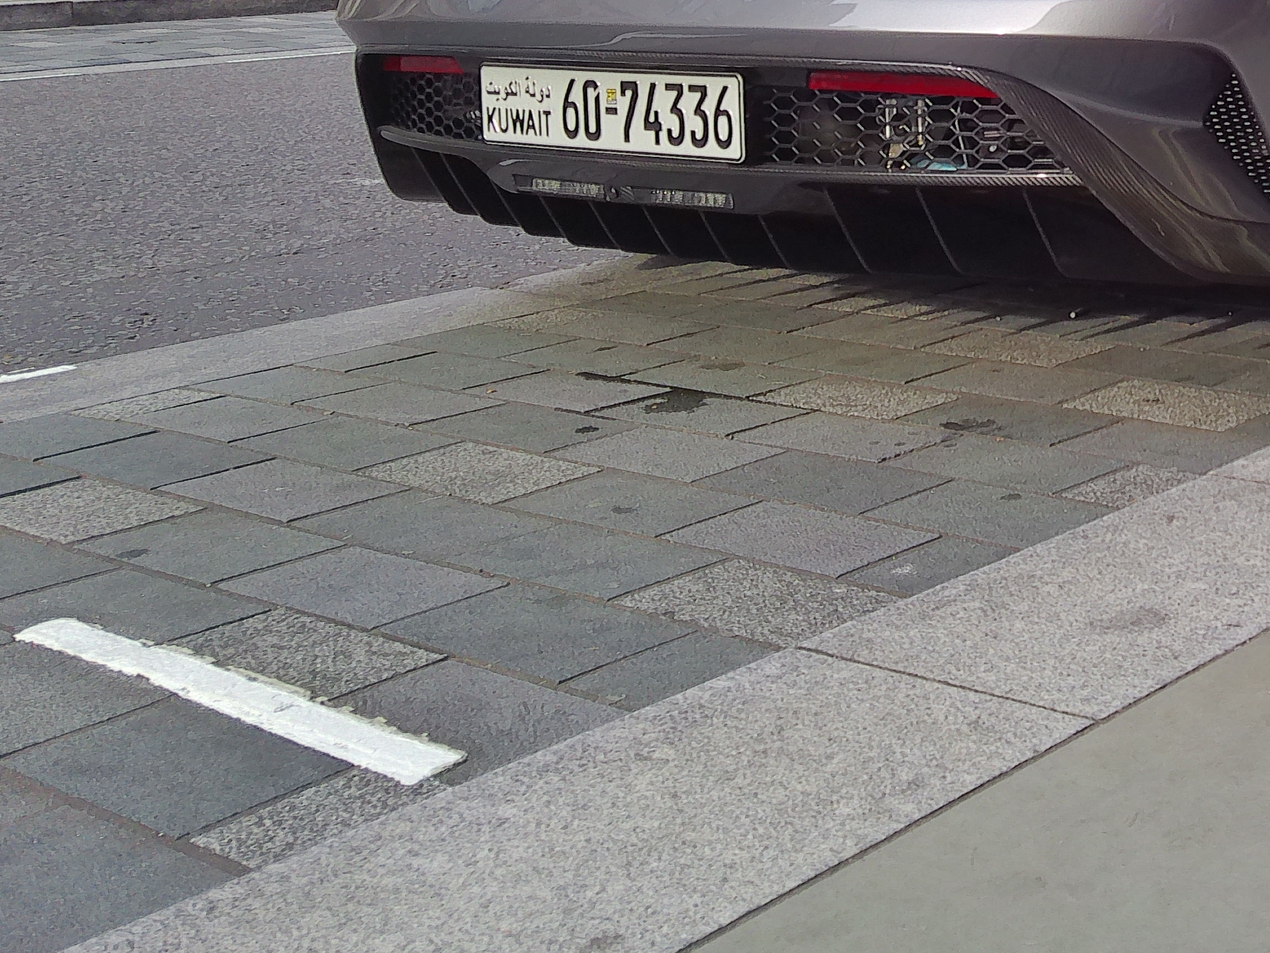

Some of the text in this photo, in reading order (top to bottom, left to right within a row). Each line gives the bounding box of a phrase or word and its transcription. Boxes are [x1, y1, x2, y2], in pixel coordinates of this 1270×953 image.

[485, 76, 552, 104] دولة الكويت
[486, 106, 552, 138] KUWAIT
